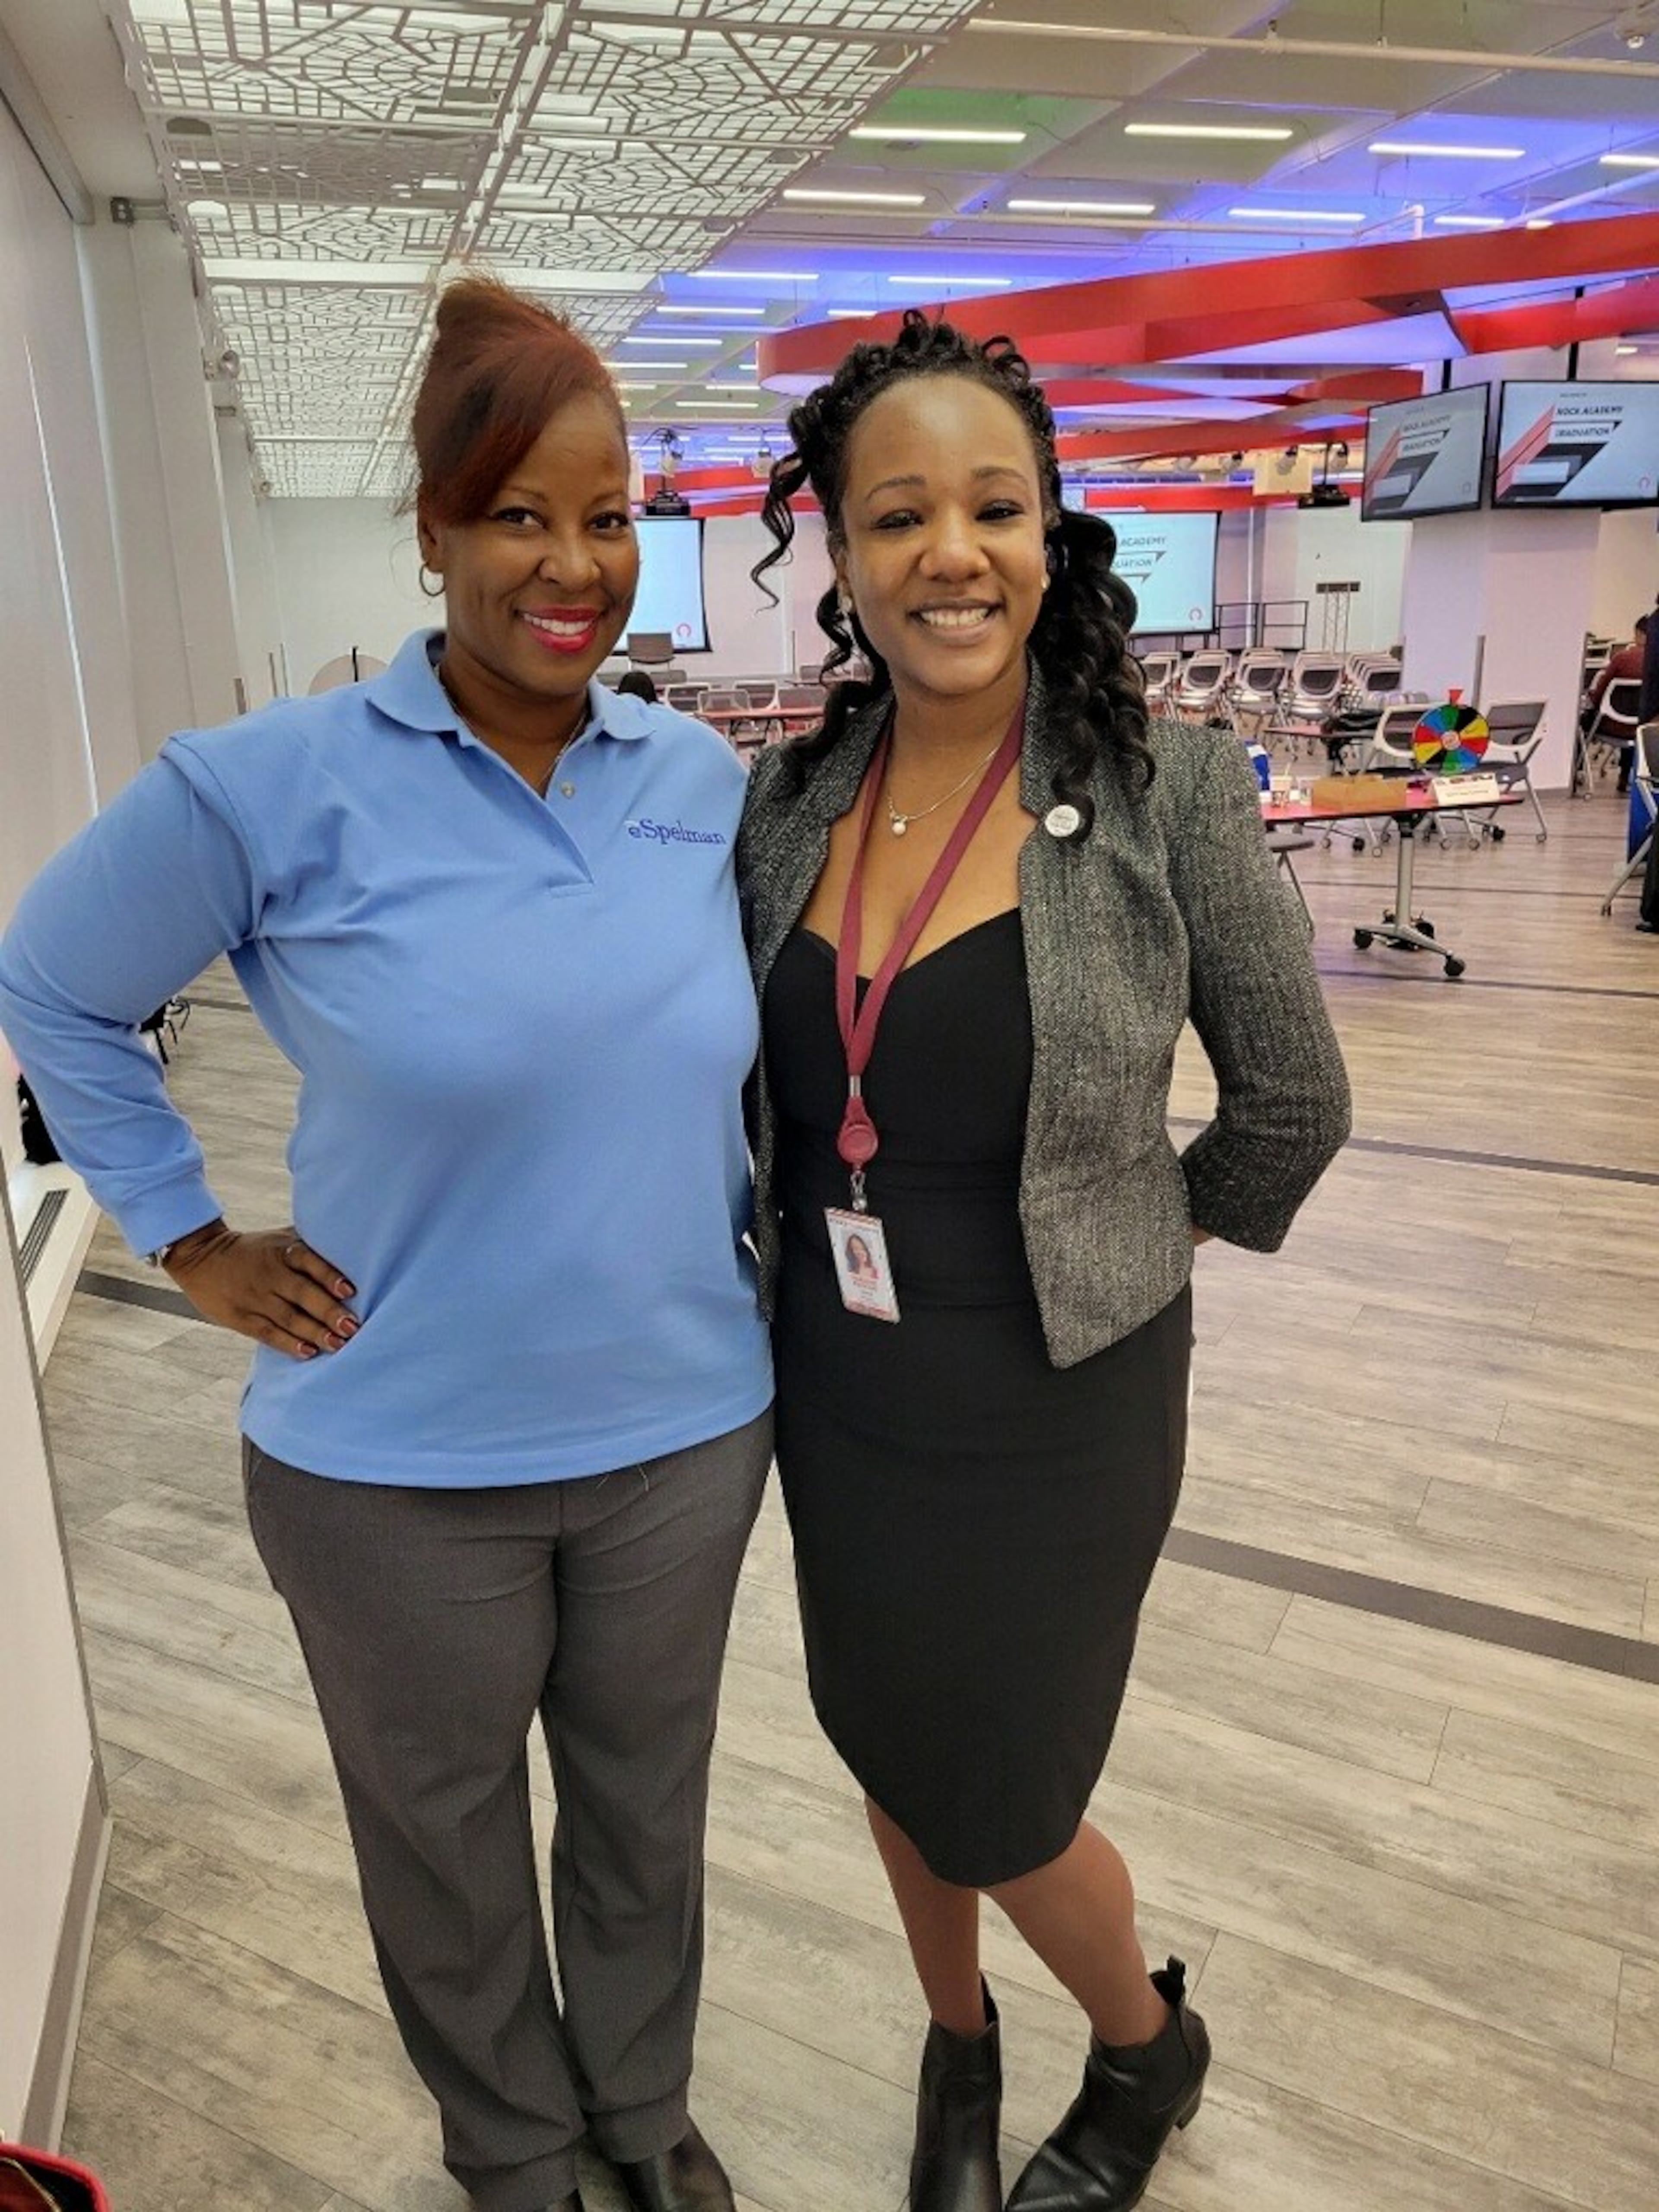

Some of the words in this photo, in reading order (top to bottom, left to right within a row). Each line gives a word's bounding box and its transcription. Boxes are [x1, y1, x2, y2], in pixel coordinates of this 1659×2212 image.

[1581, 405, 1623, 416] ACADEMY
[1120, 536, 1166, 547] ACADEMY
[629, 819, 727, 845] eSpelman
